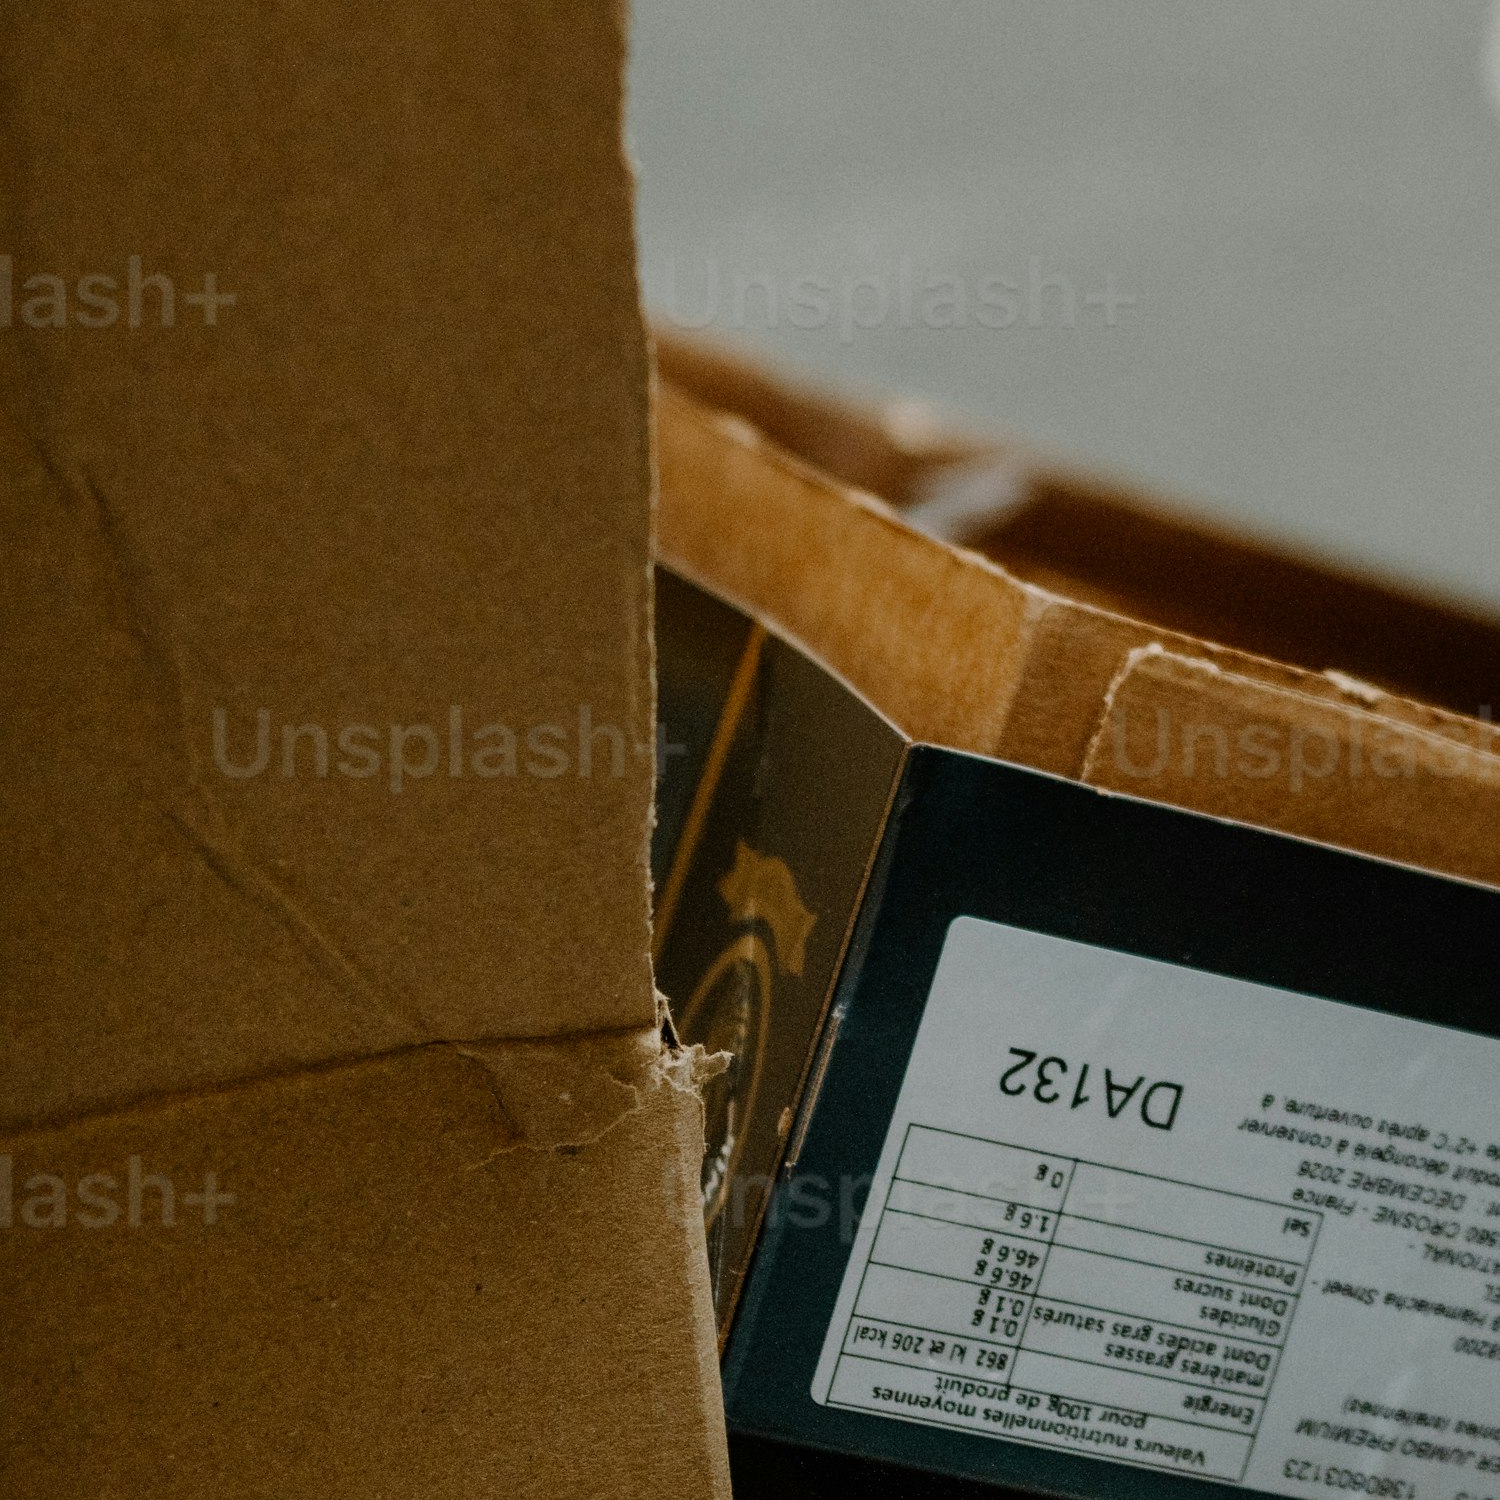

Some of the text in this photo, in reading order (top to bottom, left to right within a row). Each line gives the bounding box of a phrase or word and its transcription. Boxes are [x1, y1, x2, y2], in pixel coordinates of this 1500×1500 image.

[999, 1047, 1184, 1131] DA132
[1238, 1119, 1332, 1149] conserver
[1036, 1163, 1064, 1190] 0 g
[1292, 1188, 1354, 1216] France
[1004, 1203, 1050, 1234] 1.6 g
[1283, 1218, 1310, 1237] Sel
[981, 1238, 1040, 1269] 46.6 g
[1205, 1251, 1297, 1287] Protéines
[974, 1259, 1033, 1291] 46.6 g
[978, 1286, 1025, 1317] 0.1 g
[1174, 1277, 1289, 1317] Dont sucres
[853, 1326, 888, 1347] kcal
[971, 1308, 1019, 1338] 0.1 g
[1200, 1305, 1281, 1338] Glucides
[892, 1332, 925, 1355] 206
[928, 1340, 946, 1354] et
[1033, 1306, 1272, 1372] Dont acides gras saturés
[976, 1348, 1009, 1371] 862
[1105, 1343, 1265, 1388] matières grasses
[935, 1376, 1151, 1429] pour 100g de produit
[1183, 1394, 1255, 1426] Energie
[872, 1386, 1206, 1466] Valeurs nutritionnelles moyennes
[1295, 1419, 1397, 1452] PREMIUM
[1400, 1438, 1475, 1464] JUMBO
